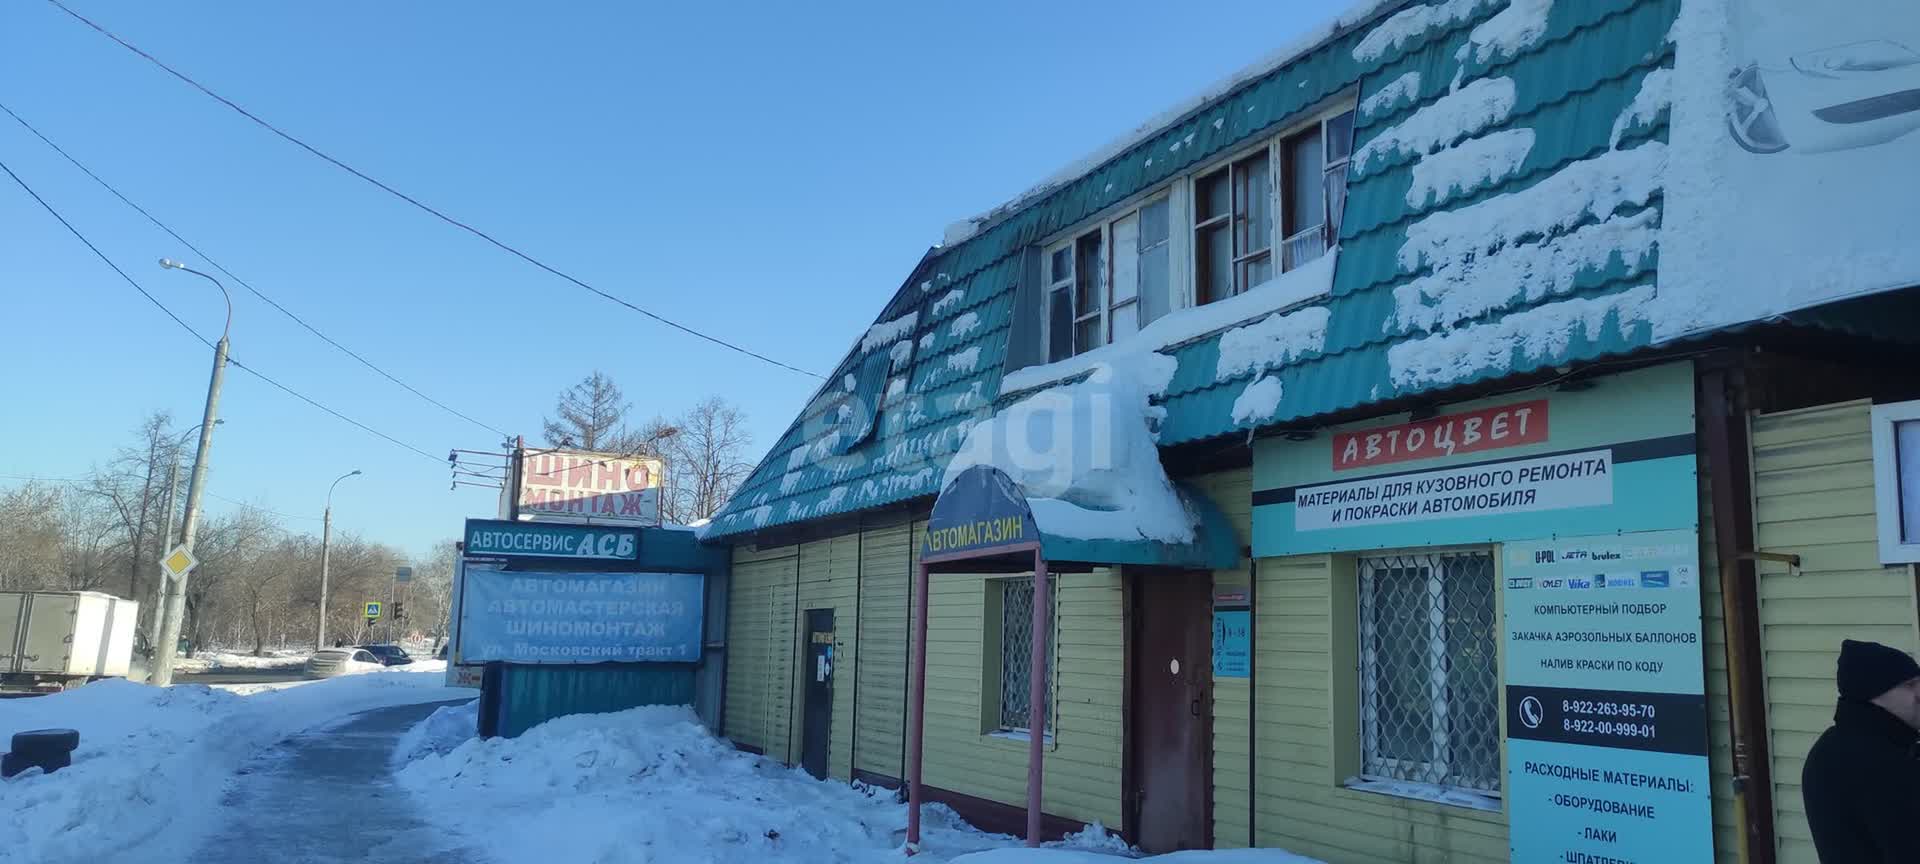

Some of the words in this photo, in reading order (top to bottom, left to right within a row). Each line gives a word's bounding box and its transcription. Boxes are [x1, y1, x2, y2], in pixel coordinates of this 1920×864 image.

[1341, 408, 1532, 458] АВТОЦВЕТ
[527, 455, 650, 491] ШИНО
[1297, 485, 1379, 508] МАТЕРИАЛЫ
[1381, 481, 1412, 502] ДЛЯ
[1416, 470, 1513, 494] КУЗОВНОГО
[1518, 458, 1607, 484] РЕМОНТА
[1331, 508, 1341, 523] И
[1344, 501, 1418, 521] ПОКРАСКИ
[1421, 489, 1537, 514] АВТОМОБИЛЯ
[921, 515, 1023, 552] АВТОМАГАЗИН
[470, 531, 575, 551] АВТОСЕРВИС
[576, 533, 635, 556] АСБ
[1591, 551, 1621, 561] brulex
[511, 578, 667, 593] АВТОМАГАЗИН
[1568, 578, 1591, 589] Vika
[487, 600, 684, 617] АВТОМАСТЕРСКАЯ
[1534, 603, 1619, 616] КОМПЬЮТЕРНЫЙ
[1622, 603, 1668, 617] ПОДБОР
[505, 620, 665, 637] ШИНОМОНТАЖ
[1512, 631, 1553, 642] ЗАКАЧКА
[1555, 631, 1633, 644] АЭРОЗОЛЬНЫХ
[1635, 631, 1697, 645] БАЛЛОНОВ
[513, 643, 622, 657] Московский
[628, 646, 672, 660] тракт
[1541, 658, 1574, 670] НАЛИВ
[1576, 659, 1615, 672] КРАСКИ
[1617, 661, 1633, 672] ПО
[1635, 660, 1665, 674] КОДУ
[1562, 699, 1656, 719] 8-922-263-95-70
[1563, 718, 1657, 739] 8-922-00-999-01
[1524, 761, 1601, 783] РАСХОДНЫЕ
[1603, 770, 1695, 794] МАТЕРИАЛЫ:
[1554, 793, 1656, 820] ОБОРУДОВАНИЕ
[1584, 827, 1617, 844] ЛАКИ
